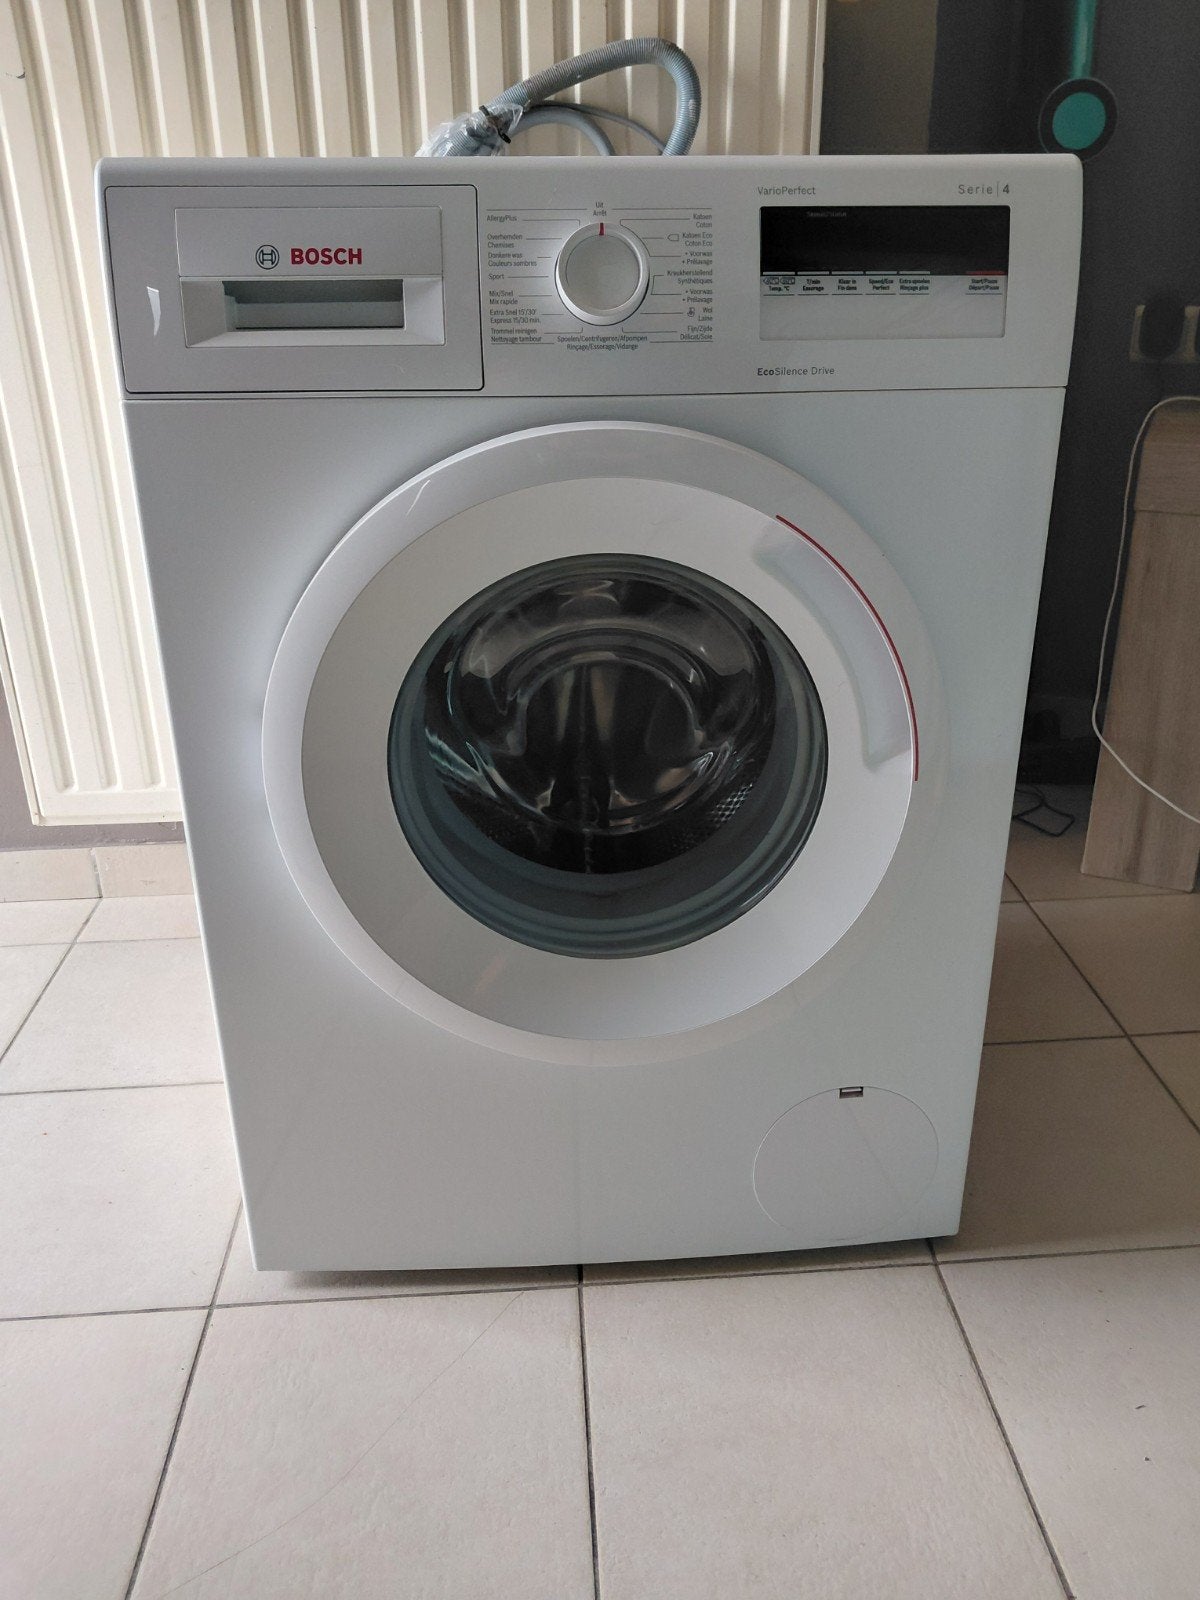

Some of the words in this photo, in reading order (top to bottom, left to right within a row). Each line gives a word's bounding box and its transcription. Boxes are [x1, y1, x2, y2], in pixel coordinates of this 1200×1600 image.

[757, 186, 816, 196] VarioPerfect
[958, 184, 993, 195] Serie
[1002, 184, 1010, 195] 4
[290, 248, 362, 265] BOSCH
[757, 367, 808, 376] EcoSilence
[811, 366, 834, 376] Drive
